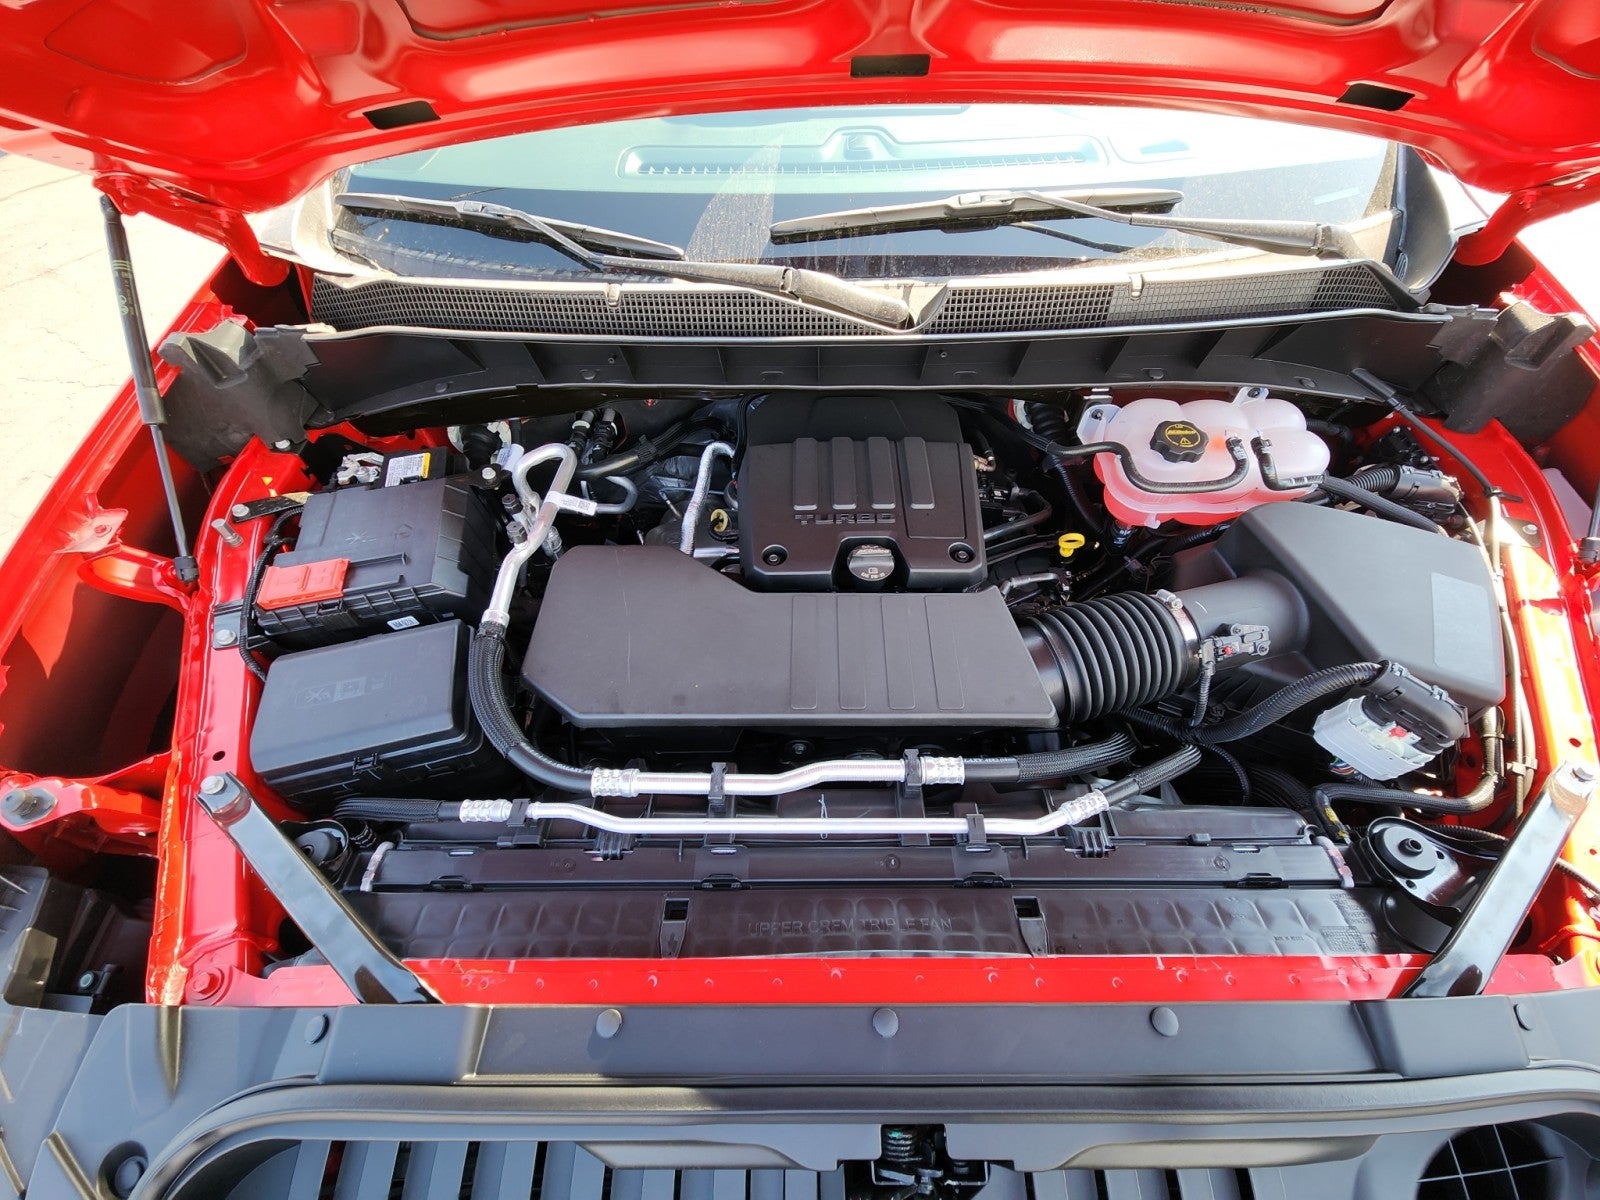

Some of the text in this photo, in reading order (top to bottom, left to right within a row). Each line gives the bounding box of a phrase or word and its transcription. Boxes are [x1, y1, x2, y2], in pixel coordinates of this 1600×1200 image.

[795, 513, 896, 525] TURBO
[747, 920, 804, 937] UPPER
[859, 917, 915, 933] TRIPLE
[919, 916, 953, 932] FAN
